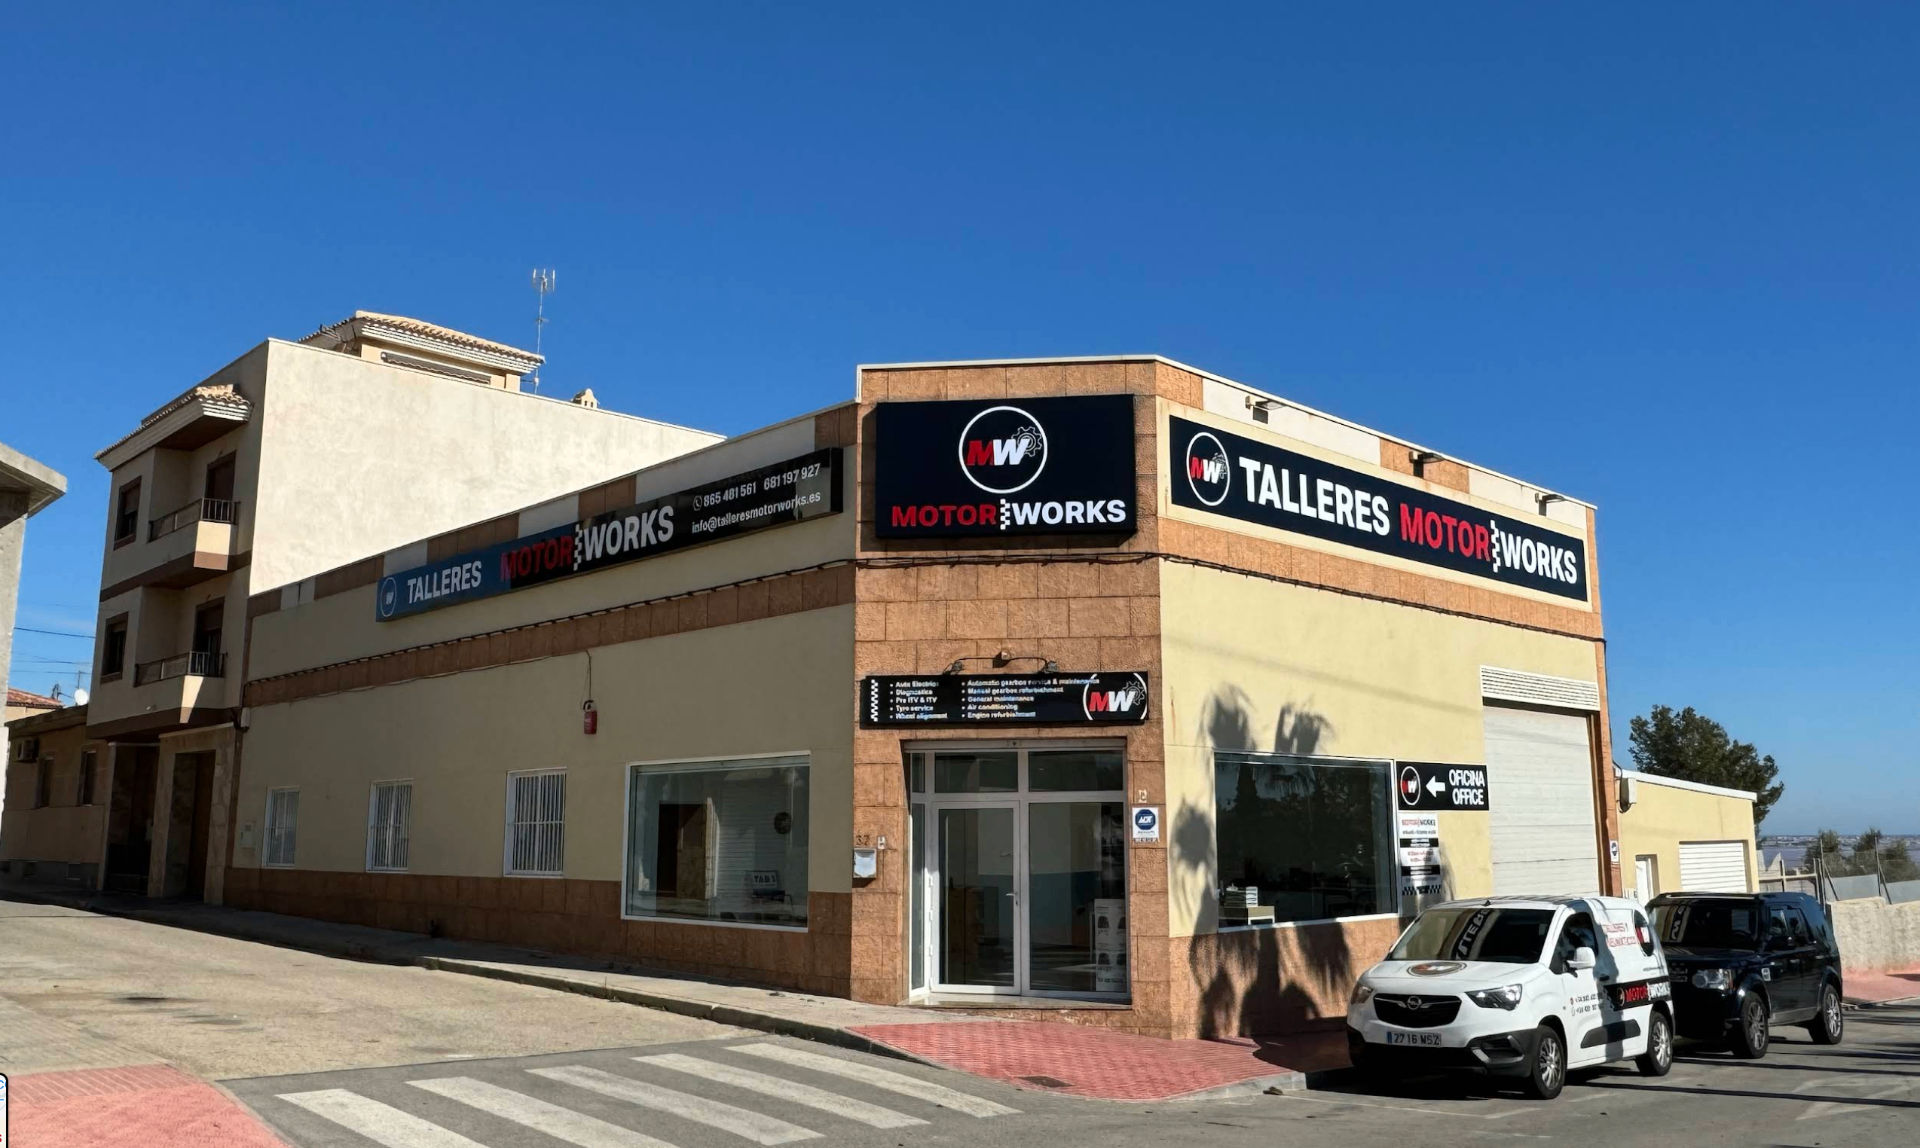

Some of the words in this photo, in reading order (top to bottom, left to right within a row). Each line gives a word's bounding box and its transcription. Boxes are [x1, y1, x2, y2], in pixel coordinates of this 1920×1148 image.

[966, 438, 1032, 466] MW
[1190, 457, 1223, 484] MW
[703, 492, 721, 507] 865
[741, 481, 757, 497] 561
[764, 475, 781, 490] 681
[782, 469, 799, 485] 197
[801, 463, 821, 479] 927
[692, 491, 821, 533] info@talleresmotorworks.es
[892, 503, 997, 527] MOTOR
[1011, 500, 1127, 525] WORKS
[1239, 456, 1390, 536] TALLERES
[1400, 503, 1490, 562] MOTOR
[1500, 531, 1578, 584] WORKS
[407, 561, 482, 604] TALLERES
[501, 535, 573, 582] MOTOR
[584, 505, 674, 561] WORKS
[967, 679, 1000, 687] Automatic
[1001, 678, 1027, 688] gearbox
[1052, 677, 1058, 685] &
[967, 687, 991, 695] Manual
[992, 687, 1018, 696] gearbox
[908, 696, 919, 704] ITV
[926, 696, 938, 704] ITV
[967, 695, 993, 703] General
[994, 694, 1035, 703] maintenance
[967, 703, 977, 711] Air
[977, 703, 1018, 712] conditioning
[1089, 690, 1137, 712] MW
[896, 704, 910, 713] Tyre
[911, 704, 934, 712] service
[967, 711, 990, 720] Engine
[990, 711, 1036, 719] refurbishment
[1448, 769, 1486, 788] OFICINA
[1452, 787, 1485, 806] OFFICE
[1393, 1033, 1418, 1044] 2716
